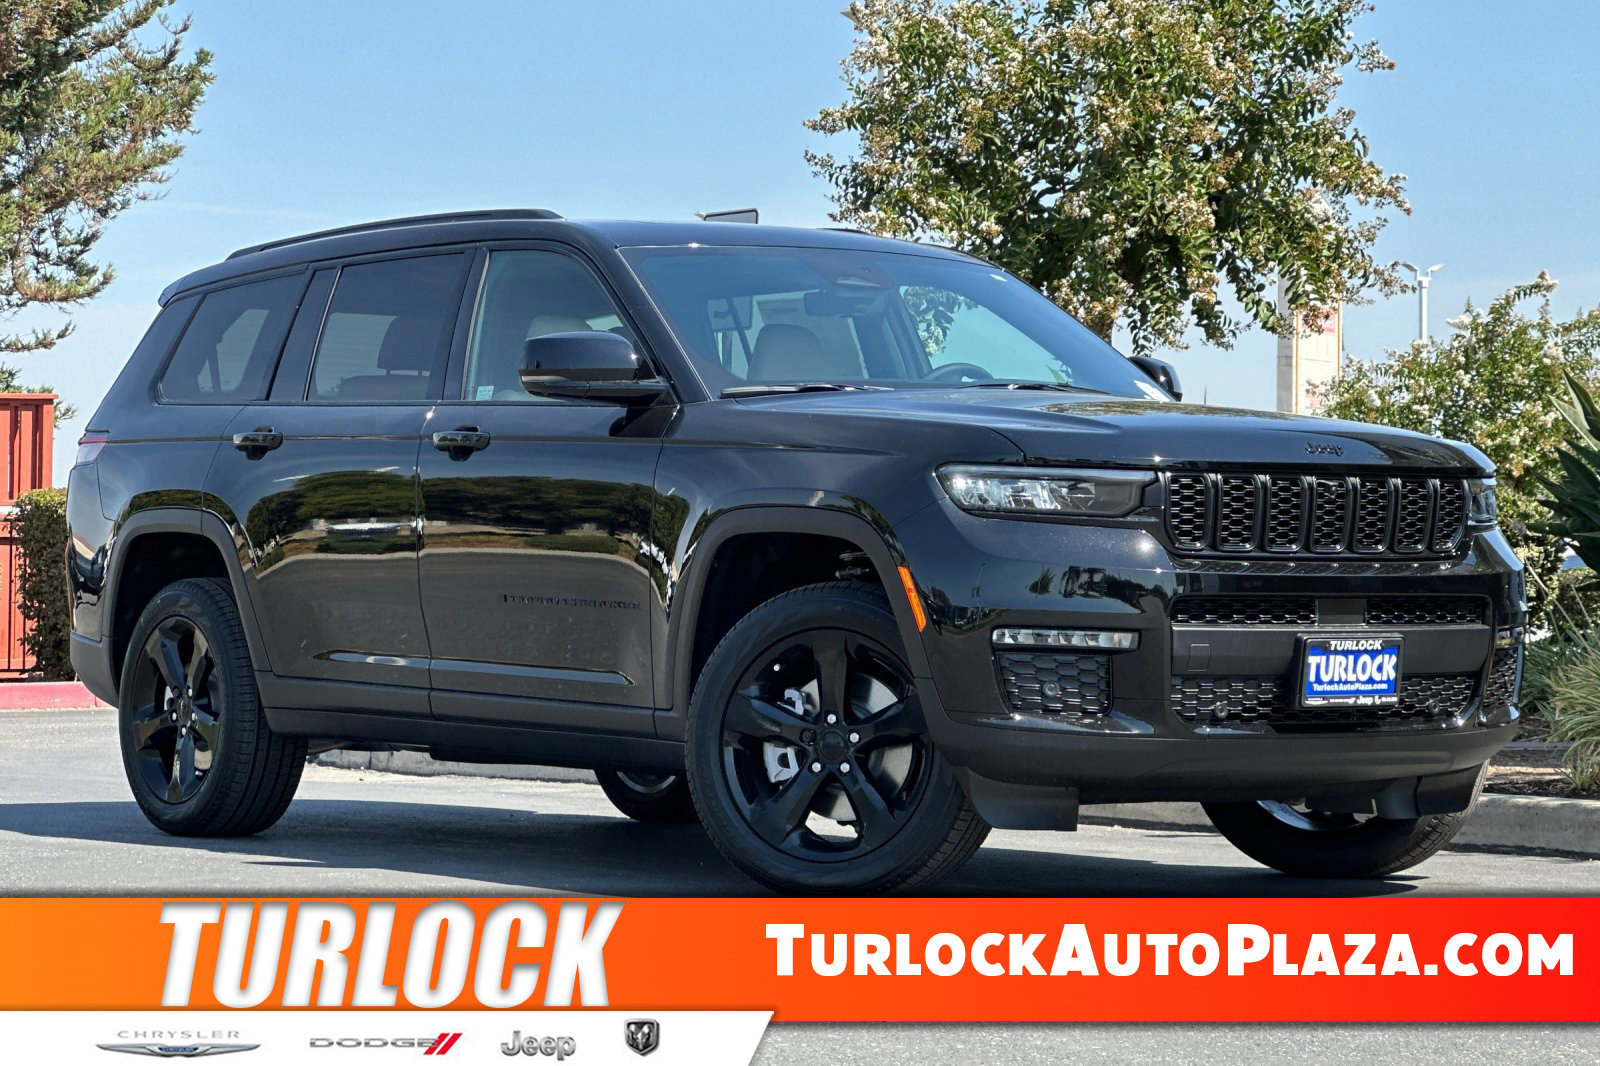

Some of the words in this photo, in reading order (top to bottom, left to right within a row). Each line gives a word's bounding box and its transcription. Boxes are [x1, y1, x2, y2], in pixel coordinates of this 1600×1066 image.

[1305, 440, 1344, 457] Jeep
[1329, 640, 1383, 650] TURLOCK
[1308, 654, 1398, 682] TURLOCK
